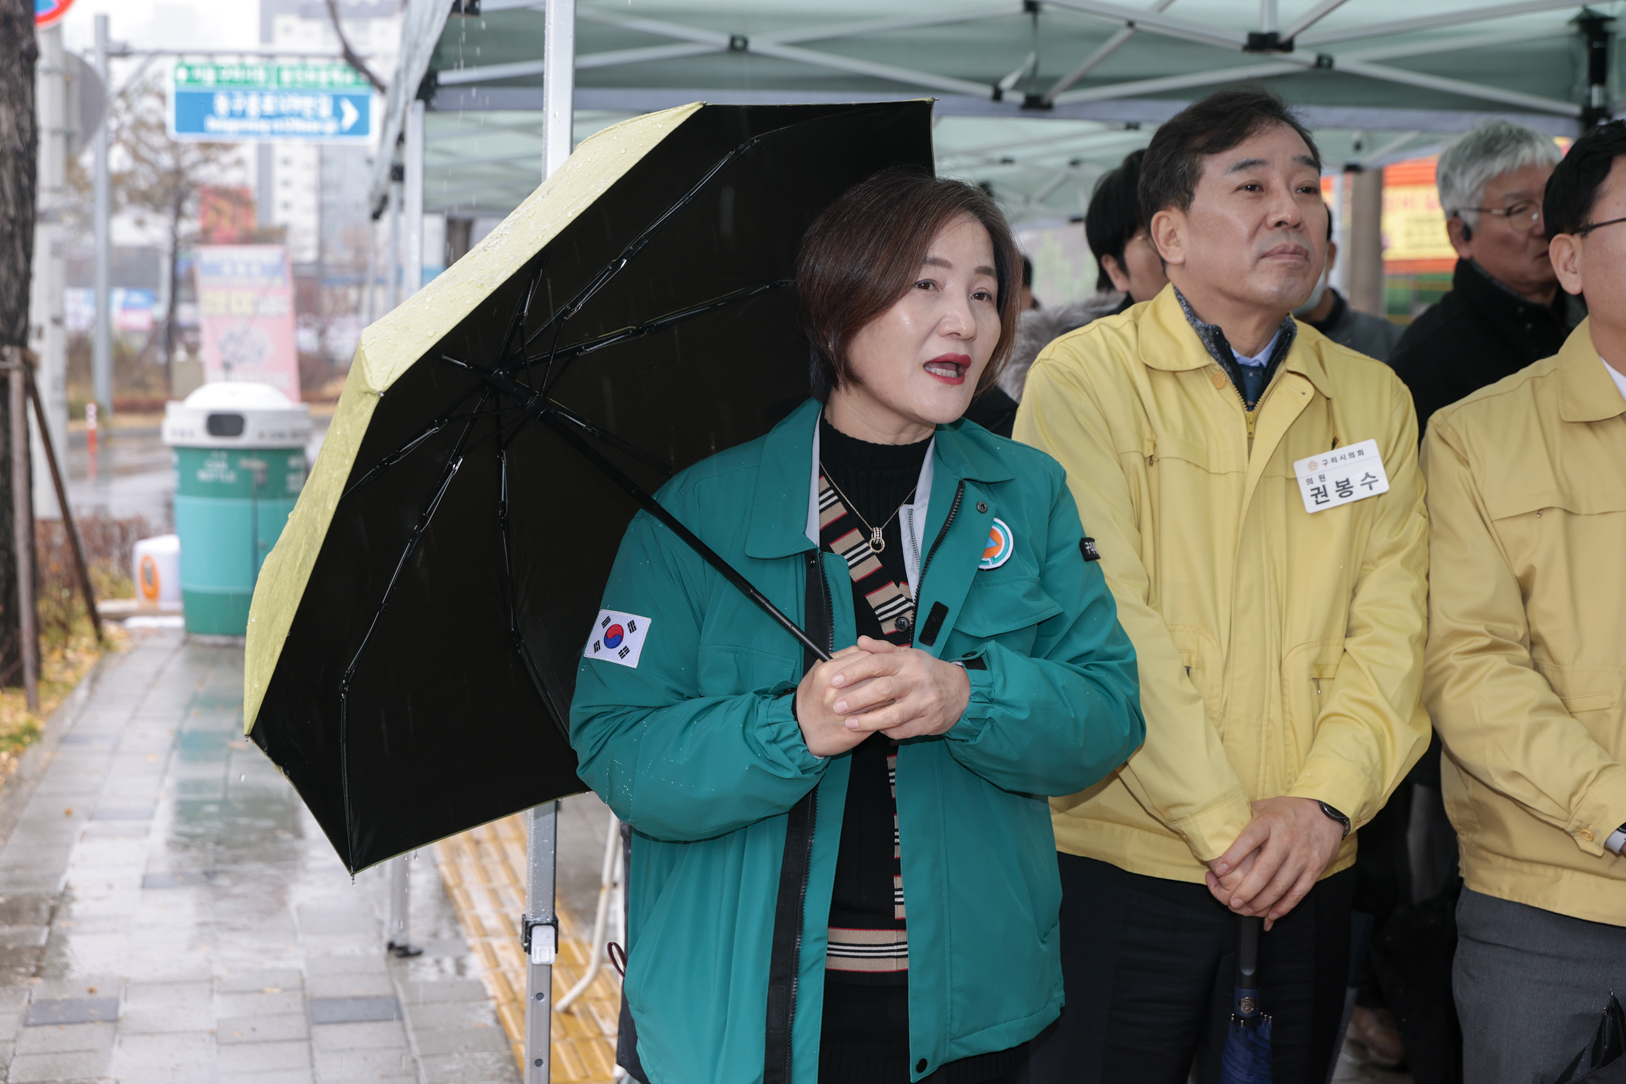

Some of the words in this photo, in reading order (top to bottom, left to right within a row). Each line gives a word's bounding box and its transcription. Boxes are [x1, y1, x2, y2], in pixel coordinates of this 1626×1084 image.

[1321, 449, 1365, 466] 구리시의회
[1306, 473, 1326, 485] 의원
[1310, 472, 1379, 505] 권봉수
